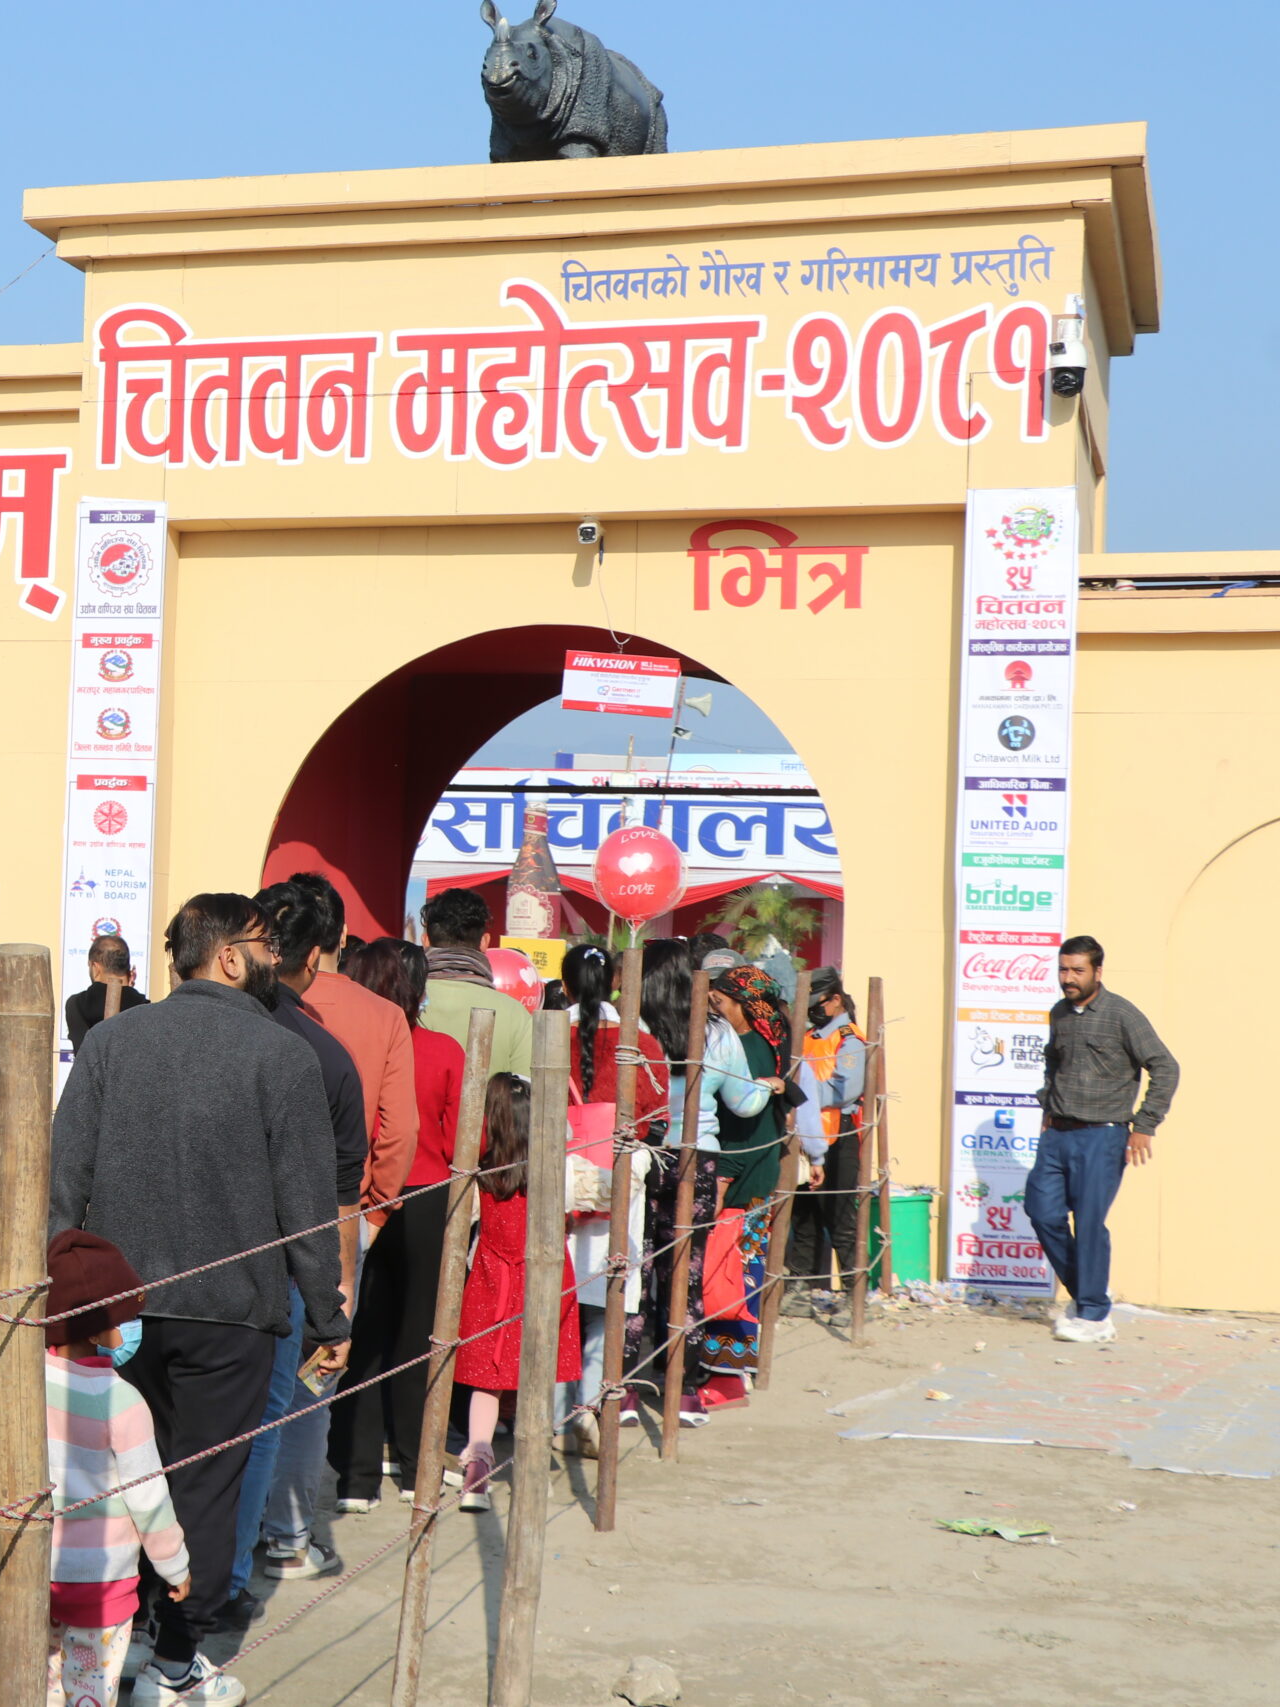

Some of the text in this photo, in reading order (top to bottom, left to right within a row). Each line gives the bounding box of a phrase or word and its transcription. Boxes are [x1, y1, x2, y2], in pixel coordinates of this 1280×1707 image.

[561, 254, 689, 303] चितवनको
[773, 261, 791, 295] र
[801, 247, 940, 295] गरिमामय
[950, 235, 1055, 297] प्रस्तुति
[99, 284, 1048, 465] चितवन महोत्सव-२०८१
[686, 519, 869, 615] भित्र
[1005, 566, 1036, 591] १५
[976, 595, 1066, 616] चितवन
[572, 656, 638, 670] HIKVISION
[1022, 754, 1041, 763] Milk
[1045, 754, 1060, 763] Ltd
[970, 820, 1058, 831] UNITED AJOD
[621, 830, 659, 844] LOVE
[105, 869, 135, 877] NEPAL
[104, 880, 147, 889] TOURISM
[619, 883, 655, 896] LOVE
[104, 892, 136, 900] BOARD
[966, 882, 1053, 911] bridge
[963, 952, 1056, 981] Coca-Cola
[962, 982, 1055, 993] Beverages Nepal
[961, 1134, 1040, 1151] GRACE
[986, 1206, 1014, 1232] १५
[957, 1233, 1044, 1260] चितवन
